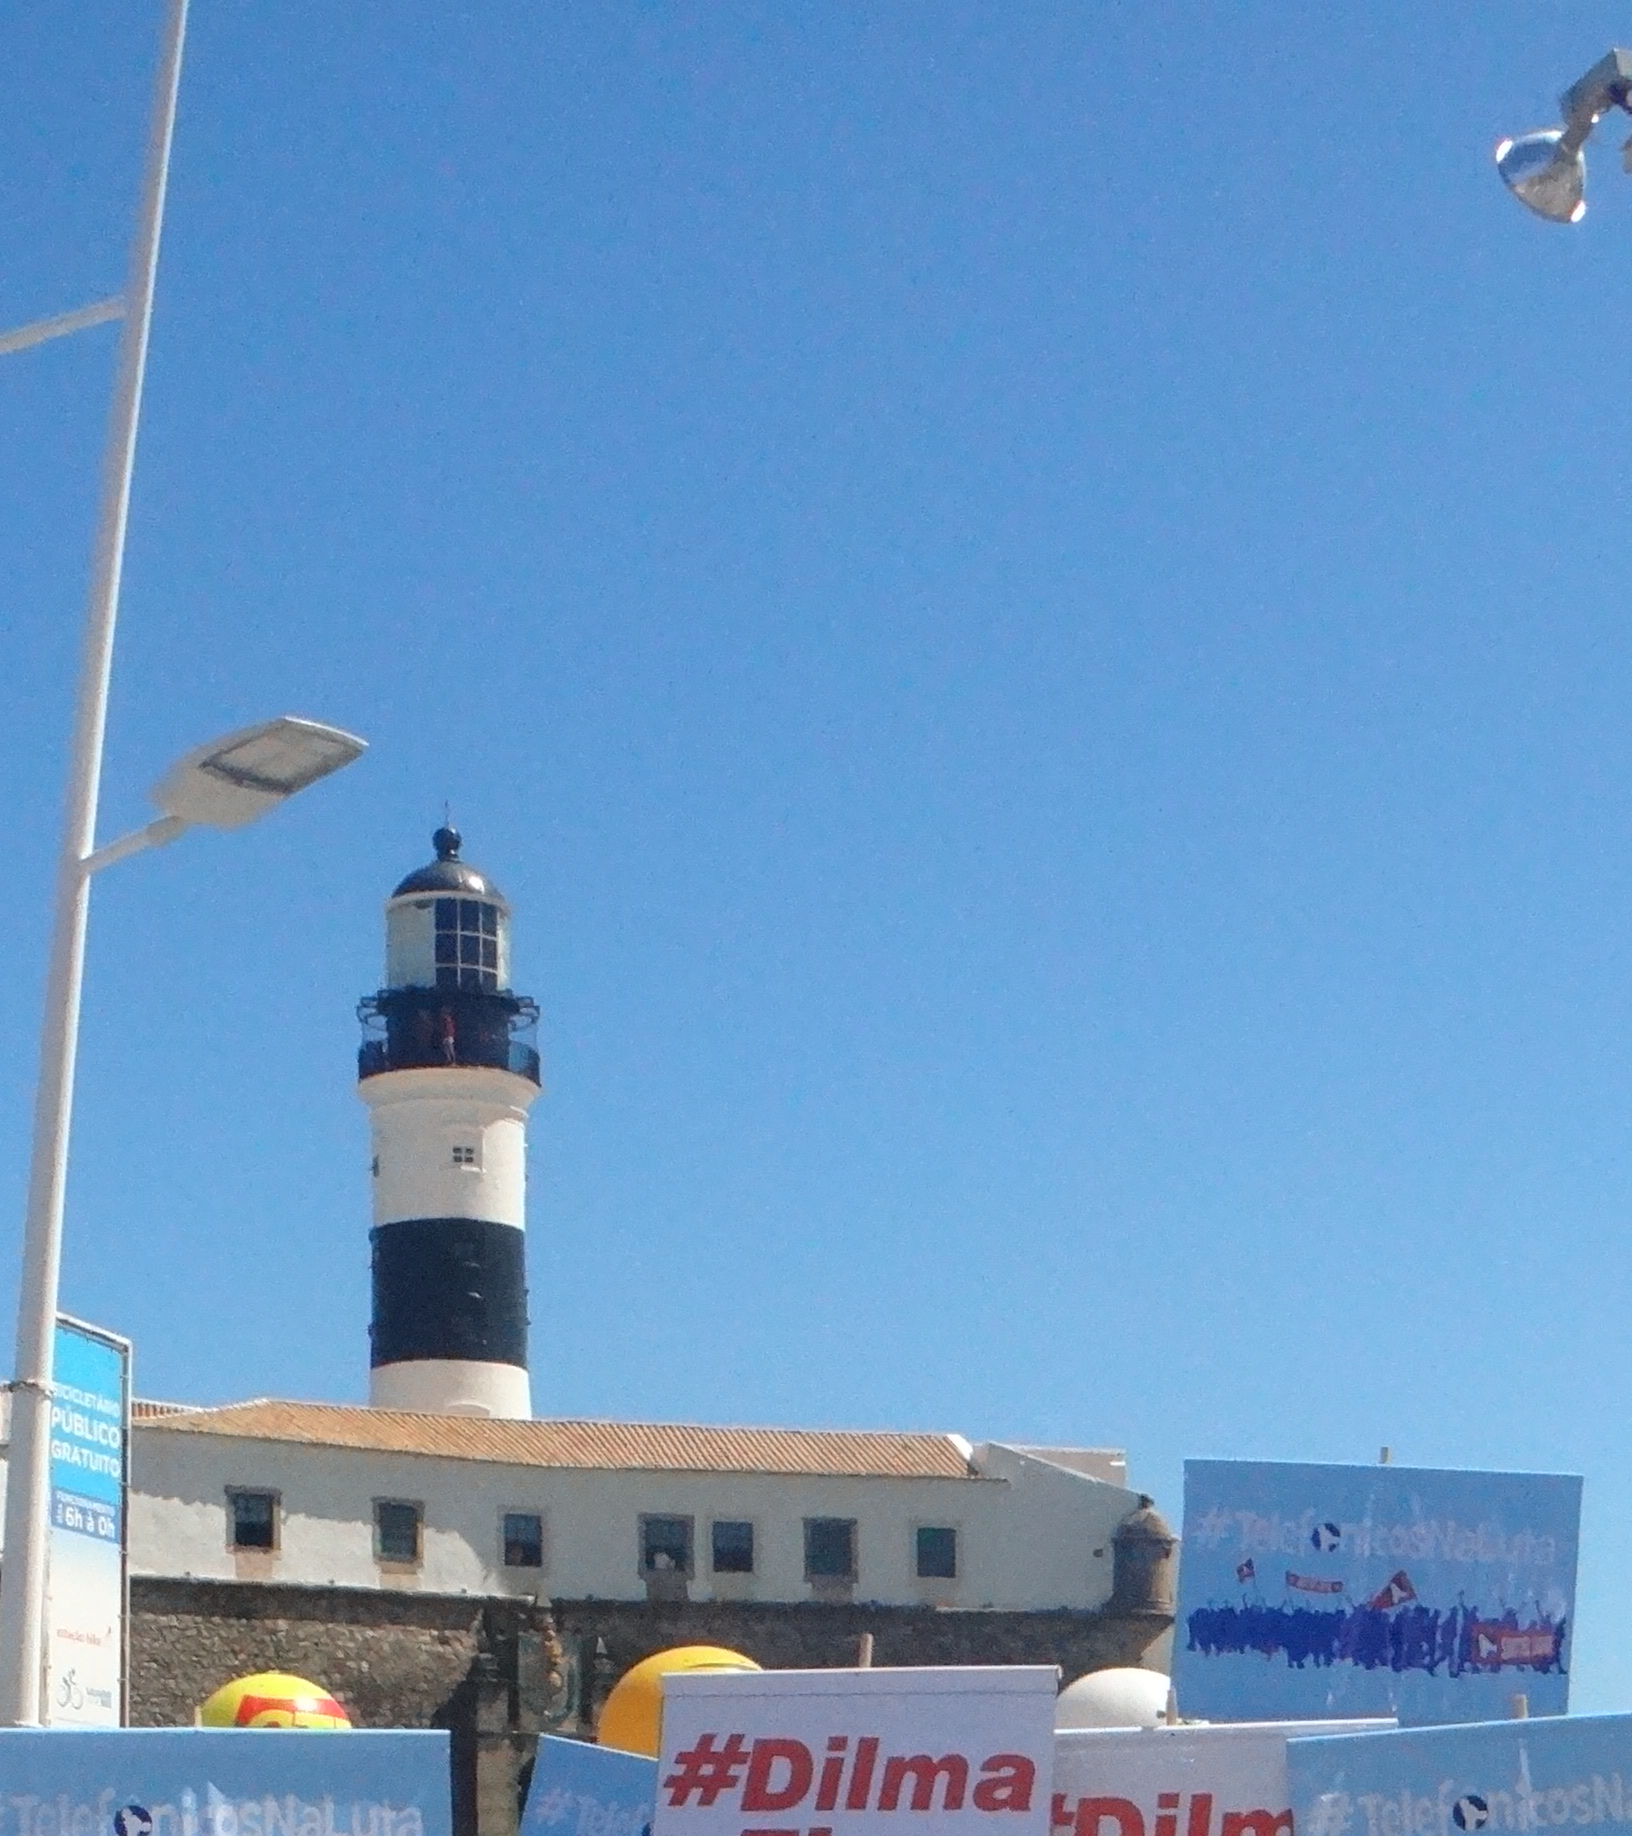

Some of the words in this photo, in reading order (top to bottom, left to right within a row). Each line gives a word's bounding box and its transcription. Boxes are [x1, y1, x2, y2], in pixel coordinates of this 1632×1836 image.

[51, 1403, 120, 1449] PÚBLICO
[51, 1440, 121, 1478] GRATUITO
[65, 1506, 83, 1530] 6h
[663, 1733, 1036, 1812] #Dilma
